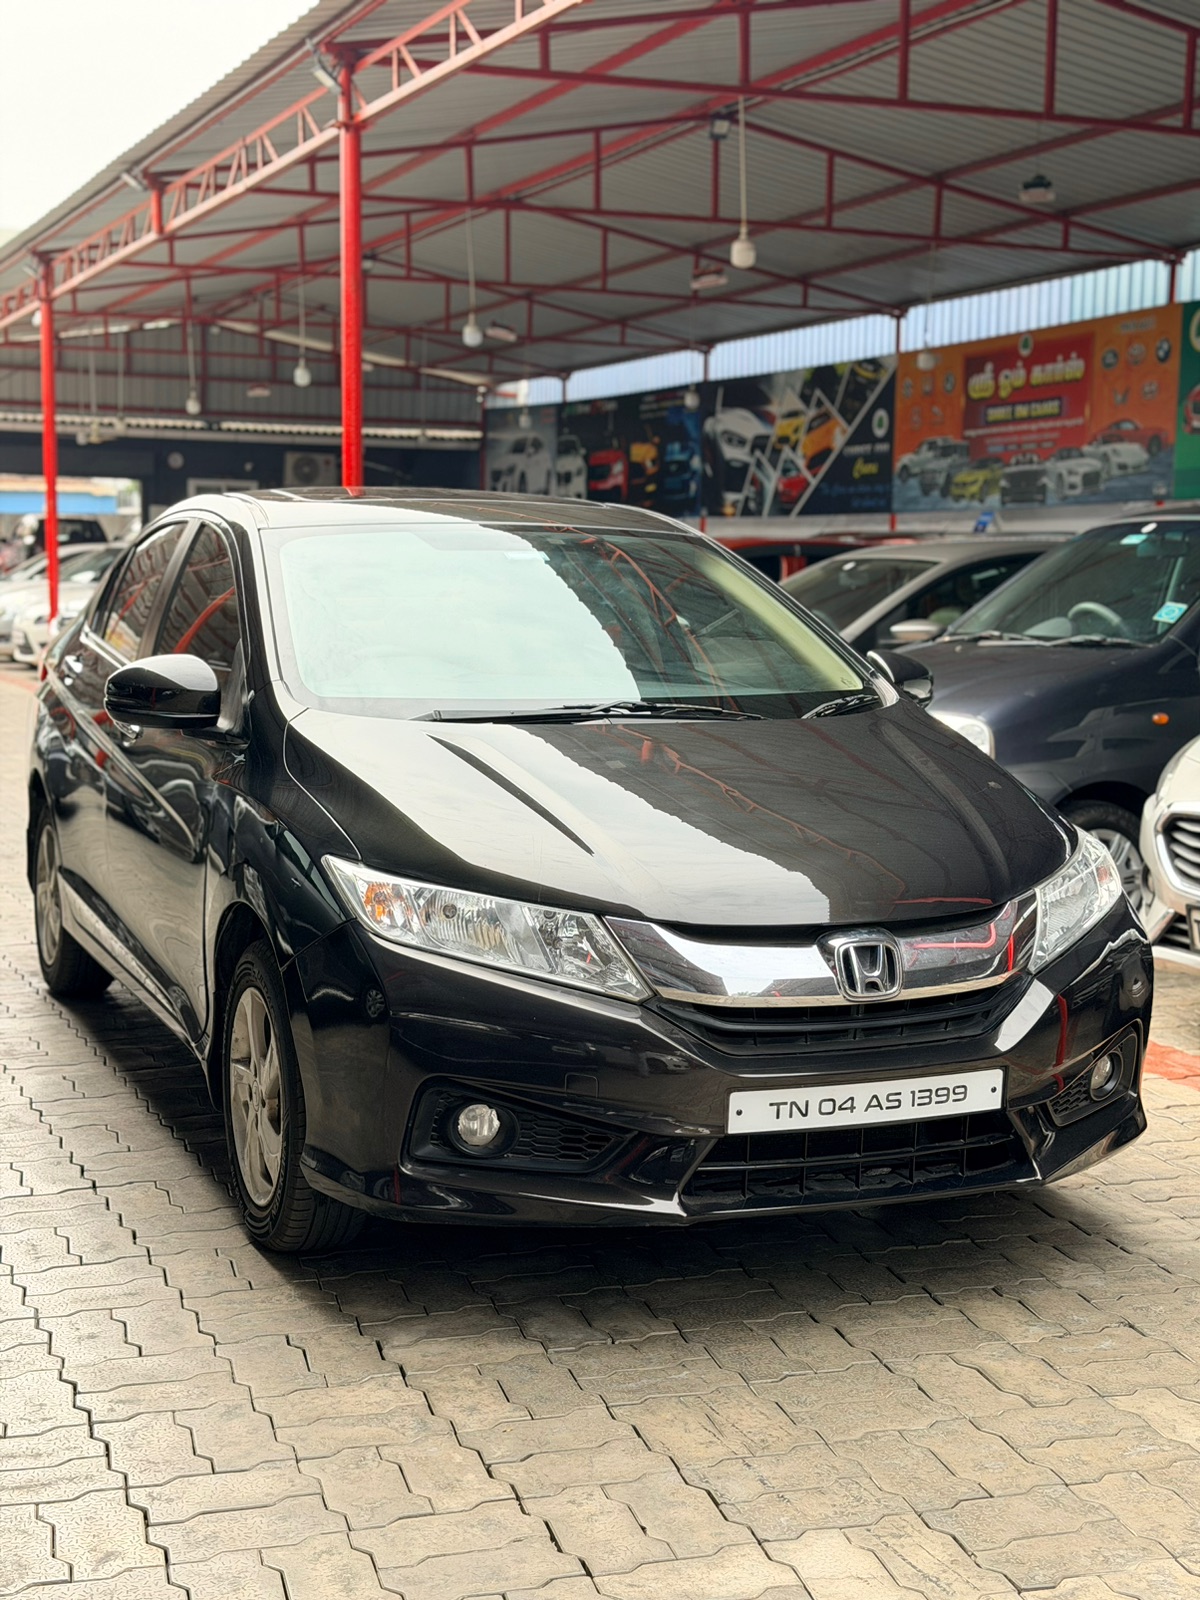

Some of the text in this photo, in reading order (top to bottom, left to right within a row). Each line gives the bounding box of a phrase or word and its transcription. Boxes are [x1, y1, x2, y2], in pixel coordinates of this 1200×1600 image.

[769, 1084, 968, 1120] TN 04 AS 1399
